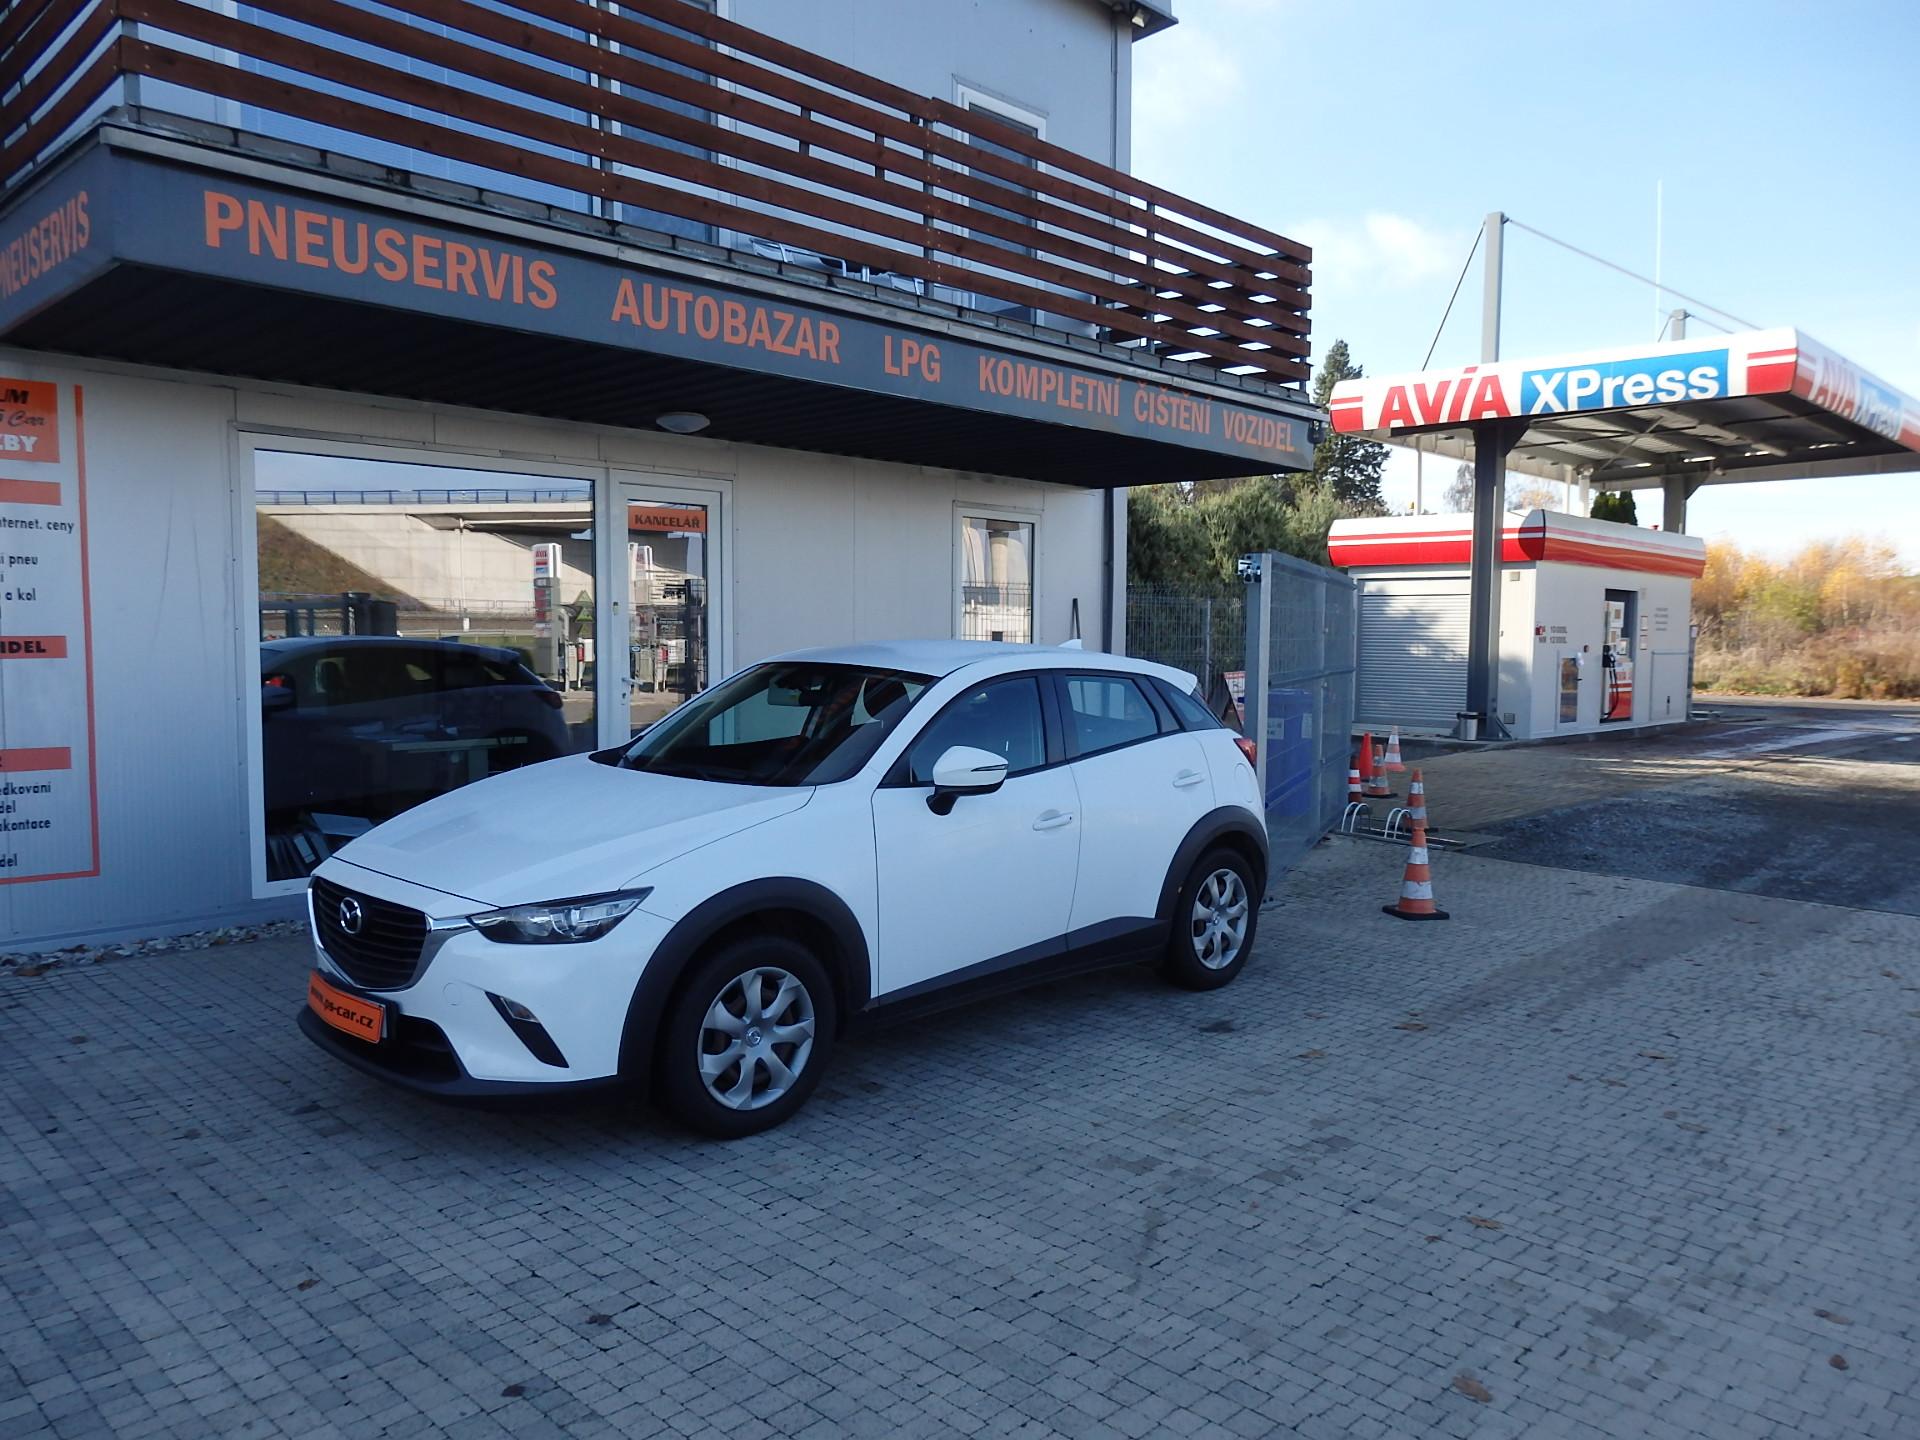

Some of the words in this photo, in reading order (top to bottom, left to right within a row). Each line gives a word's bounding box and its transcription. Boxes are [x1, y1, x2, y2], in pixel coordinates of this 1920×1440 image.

[0, 191, 90, 299] NEUSERVIS
[204, 191, 558, 310] PNEUSERVIS
[611, 278, 840, 365] AUTOBAZAR
[884, 335, 941, 383] LPG
[978, 355, 1121, 417] KOMPLETNÍ
[1134, 380, 1212, 435] ČIŠTĚNÍ
[1222, 408, 1296, 452] VOZIDEL
[1529, 366, 1720, 415] XPress
[46, 520, 75, 534] ceny
[634, 513, 701, 529] KANCELÁŘ
[9, 555, 38, 567] pneu
[17, 587, 36, 601] kol
